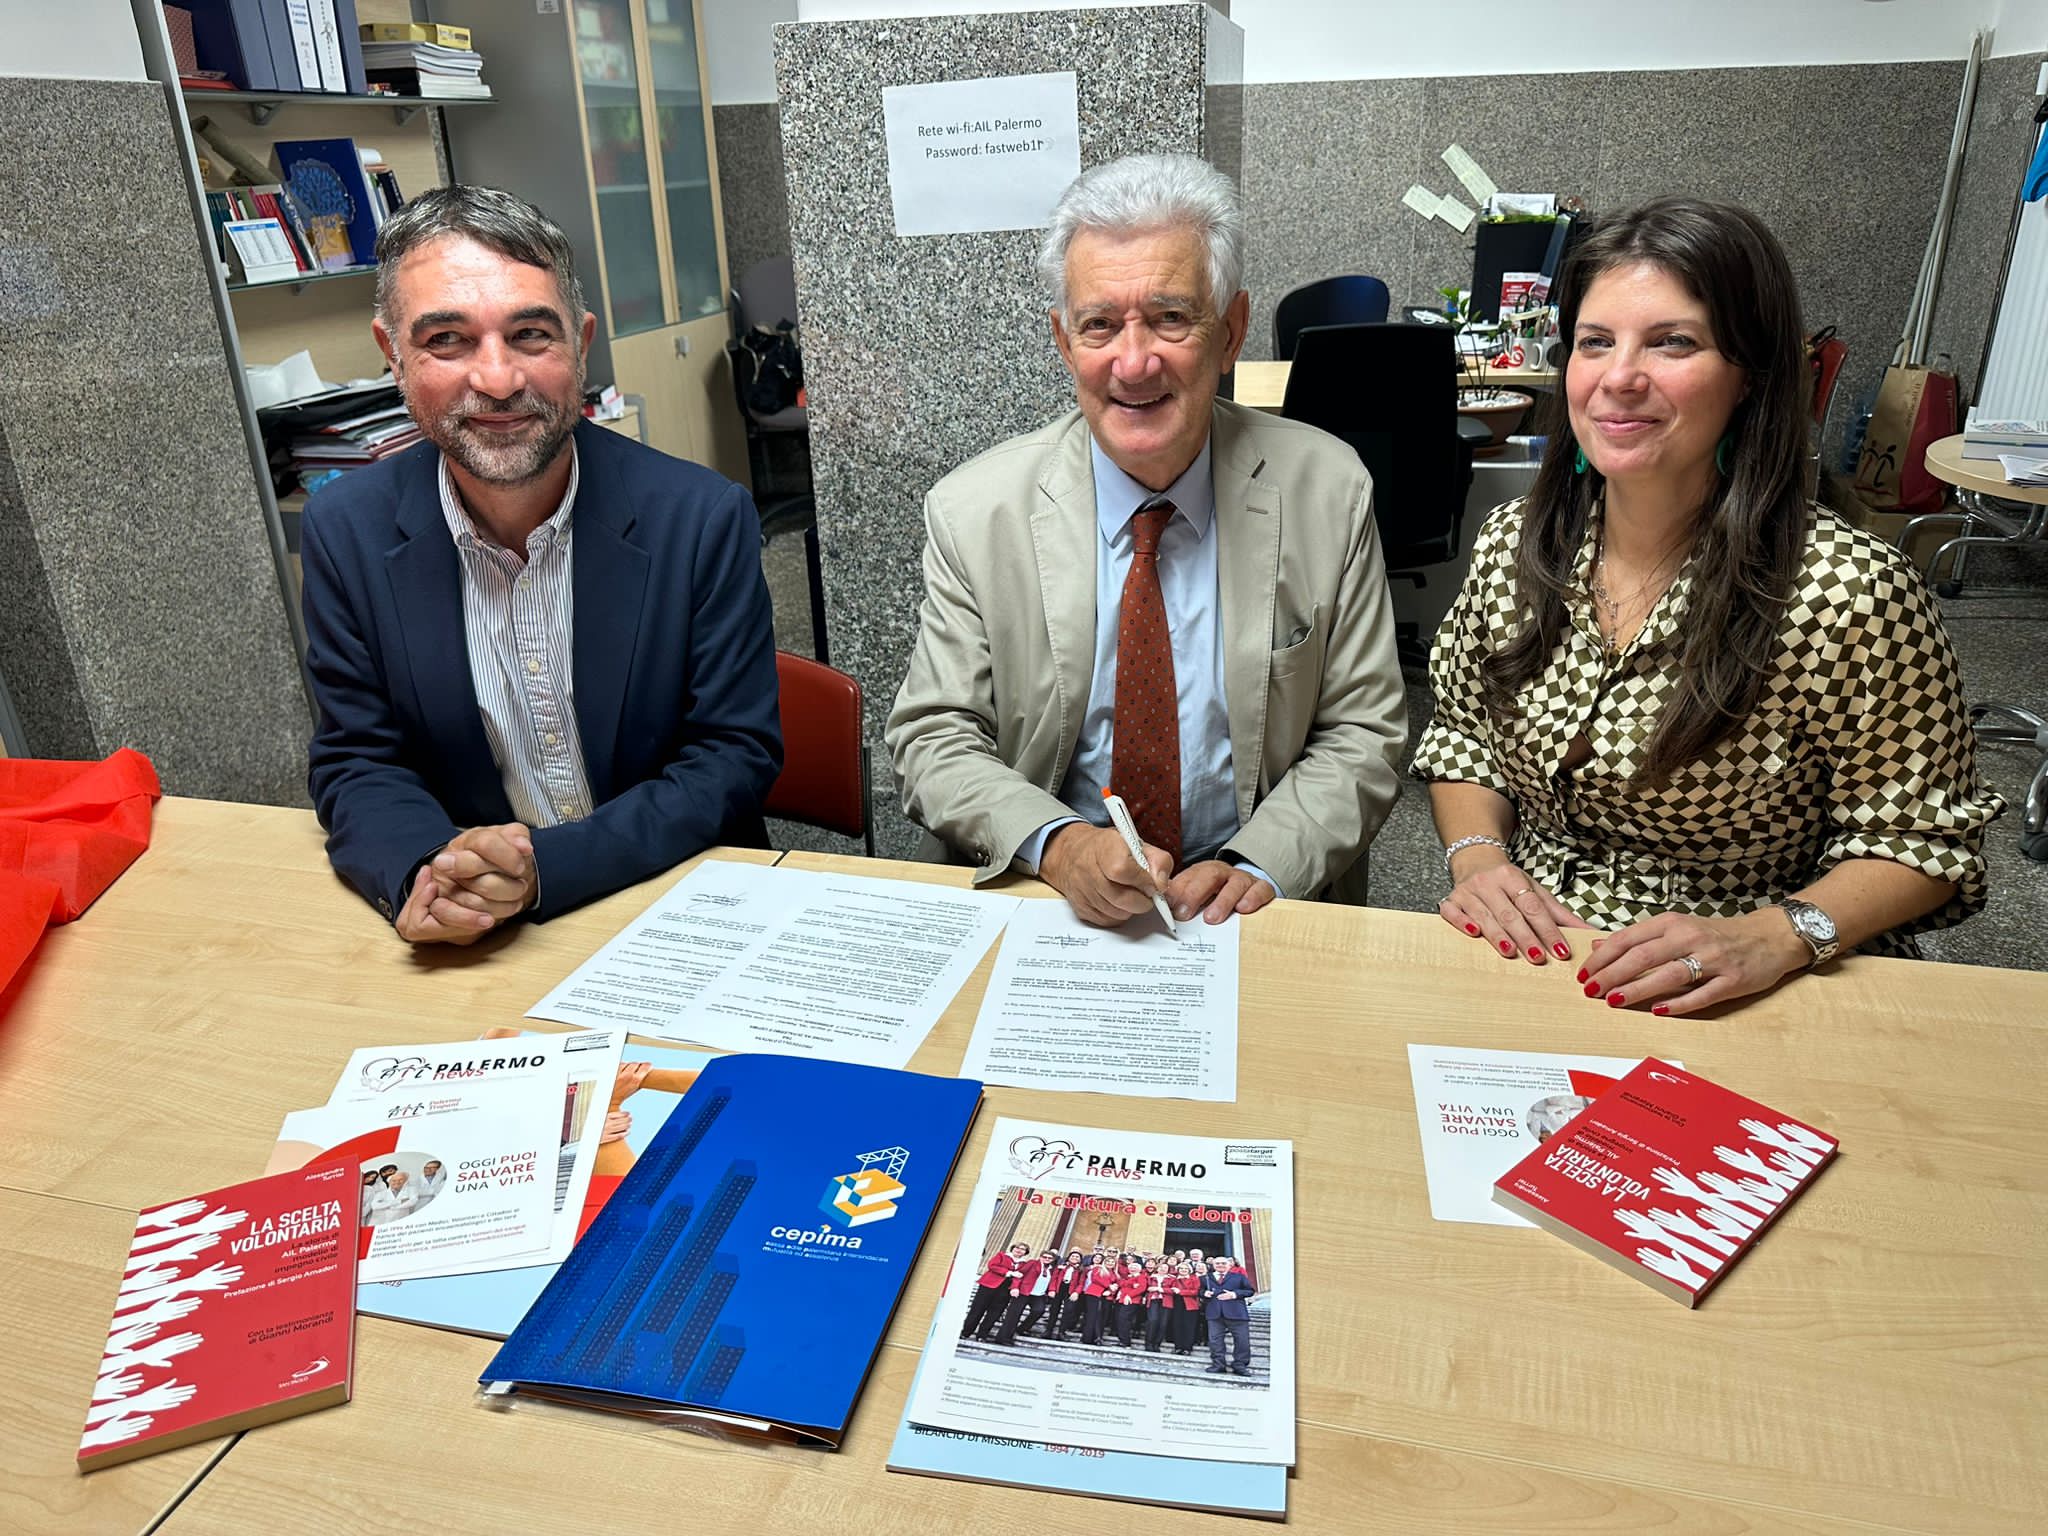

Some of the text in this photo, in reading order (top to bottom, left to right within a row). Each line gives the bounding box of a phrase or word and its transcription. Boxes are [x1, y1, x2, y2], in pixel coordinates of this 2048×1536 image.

[918, 117, 1042, 137] Rete wi-fi:AIL Palermo
[925, 143, 983, 159] Password:
[432, 1068, 485, 1080] news
[436, 1055, 546, 1073] PALERMO
[1438, 1103, 1514, 1117] UNA VITA
[1441, 1113, 1516, 1128] SALVARE
[1442, 1125, 1519, 1138] OGGI PUOI
[1574, 1134, 1606, 1150] Palermo
[459, 1151, 536, 1170] OGGI PUOI
[1645, 1146, 1681, 1166] Prefazione
[457, 1161, 536, 1182] SALVARE
[1086, 1166, 1142, 1181] news
[1088, 1155, 1206, 1178] PALERMO
[1556, 1144, 1651, 1200] VOLONTARIA
[455, 1174, 535, 1193] UNA VITA
[1544, 1153, 1626, 1202] LA SCELTA
[1017, 1189, 1043, 1205] La
[1051, 1193, 1137, 1214] cultura
[1188, 1205, 1253, 1224] dono
[250, 1200, 341, 1236] LA SCELTA
[230, 1214, 341, 1255] VOLONTARIA
[771, 1224, 863, 1249] cepima
[299, 1239, 337, 1254] Palermo
[224, 1283, 266, 1298] Prefazione
[277, 1274, 302, 1285] Sergio
[259, 1329, 291, 1342] Gianni
[293, 1315, 334, 1333] Morandi
[915, 1427, 965, 1441] BILANCIO
[968, 1433, 978, 1443] DI
[982, 1435, 1034, 1450] MISSIONE
[1043, 1443, 1069, 1455] 1994
[1071, 1447, 1076, 1457] /
[1079, 1448, 1105, 1459] 2019
